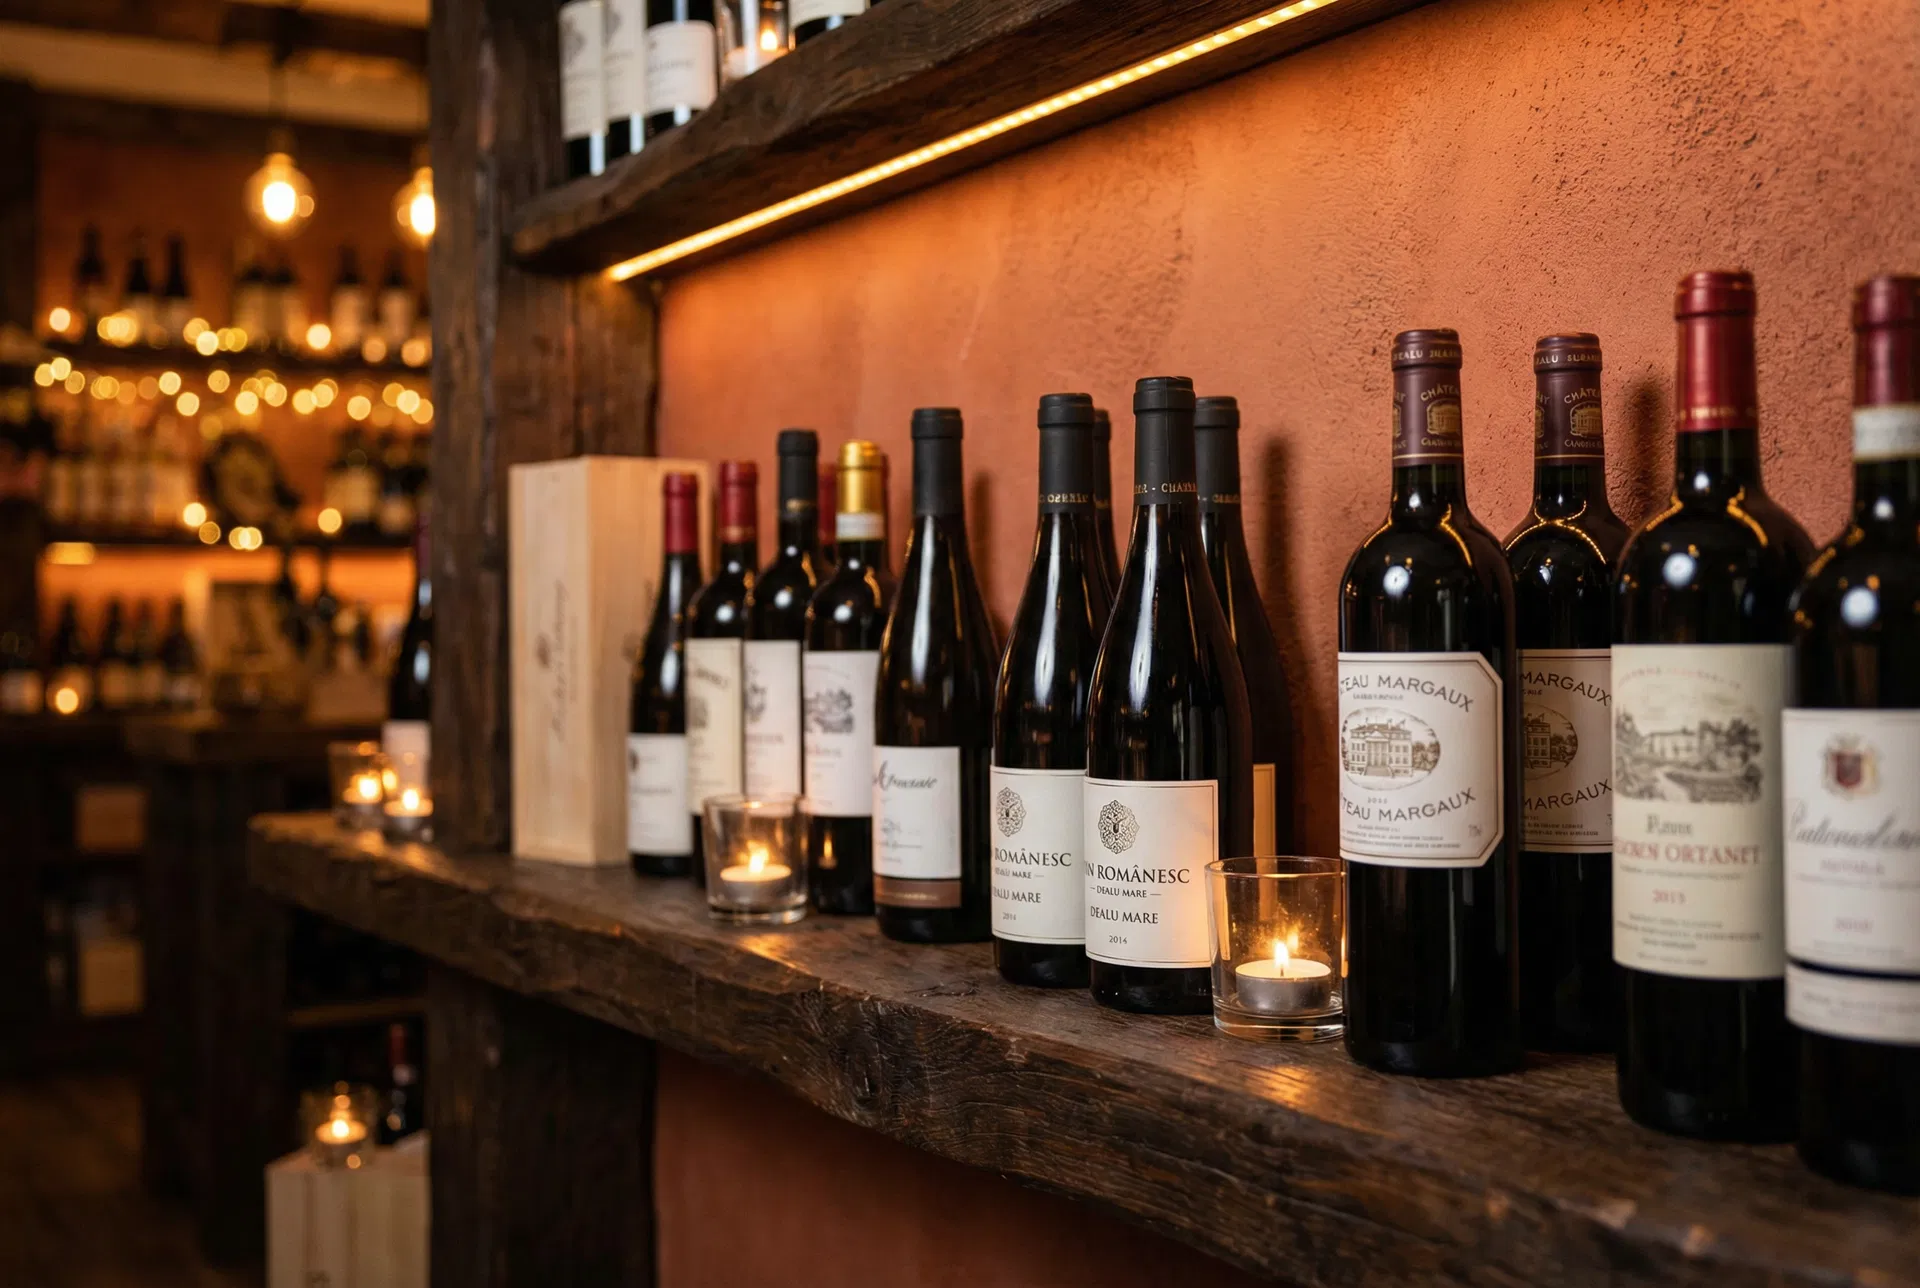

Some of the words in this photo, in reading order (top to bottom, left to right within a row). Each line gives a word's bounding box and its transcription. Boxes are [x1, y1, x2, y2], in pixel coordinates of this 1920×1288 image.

[1340, 674, 1369, 694] TEAU
[1377, 675, 1473, 713] MARGAUX
[1520, 671, 1612, 706] MARGAUX
[1341, 796, 1371, 820] TEAU
[1379, 787, 1476, 822] MARGAUX
[994, 847, 1072, 867] ROMÂNESC
[1097, 864, 1190, 884] ROMÂNESC
[1011, 891, 1042, 904] MARE
[1096, 885, 1120, 896] DEALU
[1122, 889, 1148, 898] MARE
[1090, 905, 1119, 921] DEALU
[1122, 911, 1159, 924] MARE
